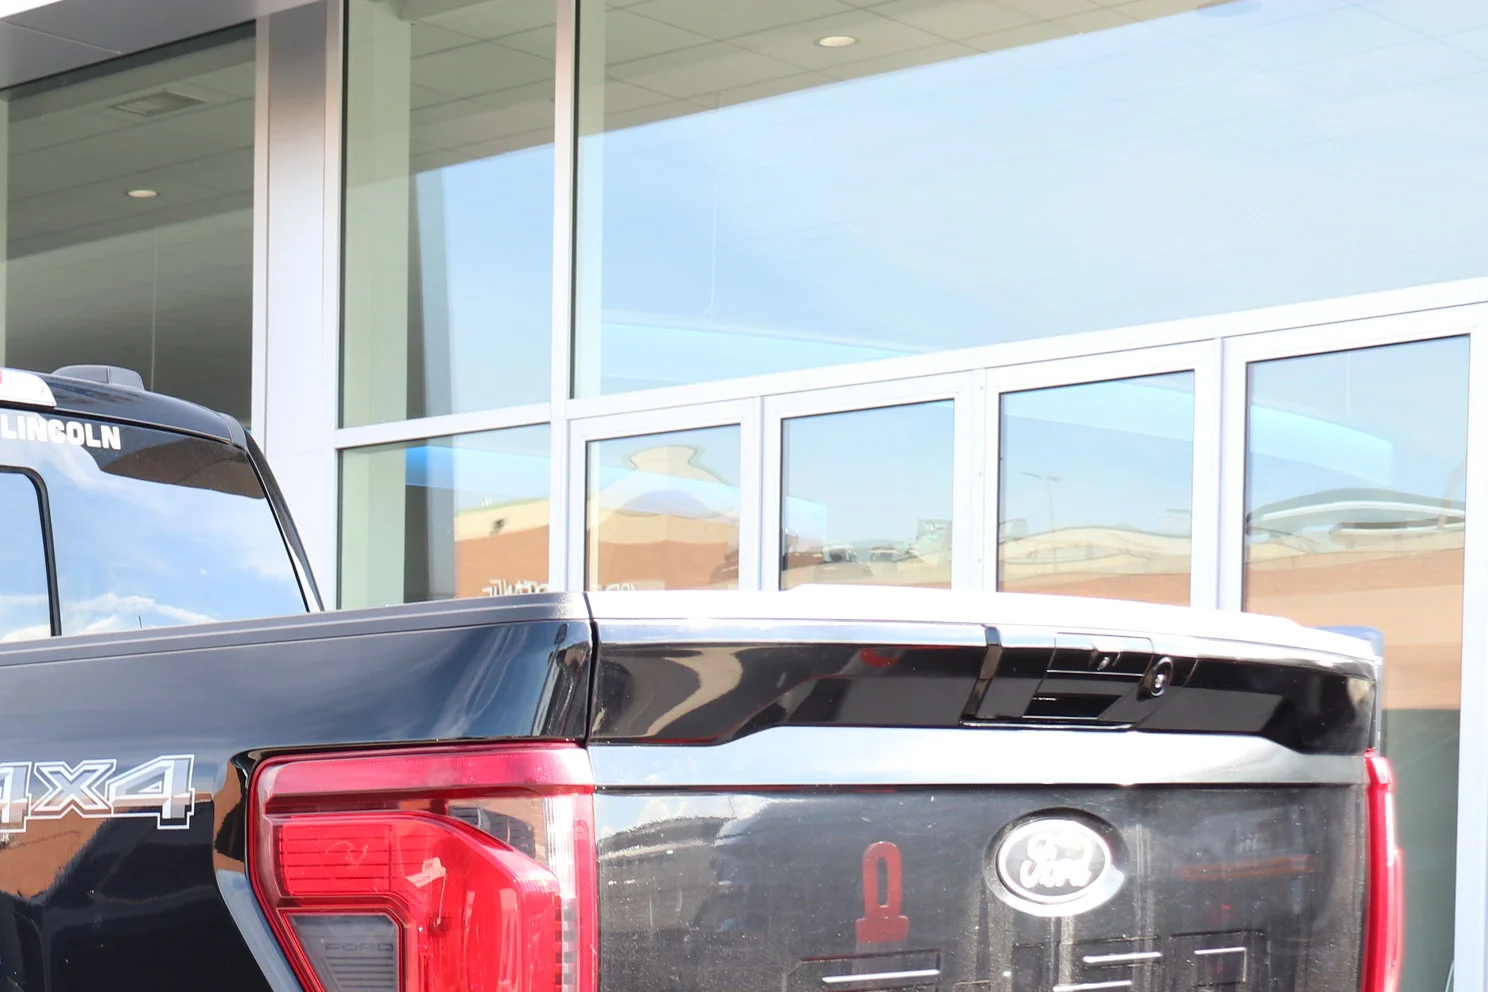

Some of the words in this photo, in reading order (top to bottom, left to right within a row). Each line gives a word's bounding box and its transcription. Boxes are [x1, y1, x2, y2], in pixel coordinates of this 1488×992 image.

[0, 413, 122, 451] LINCOLN
[1019, 831, 1094, 889] Ford
[325, 942, 394, 952] FORD
